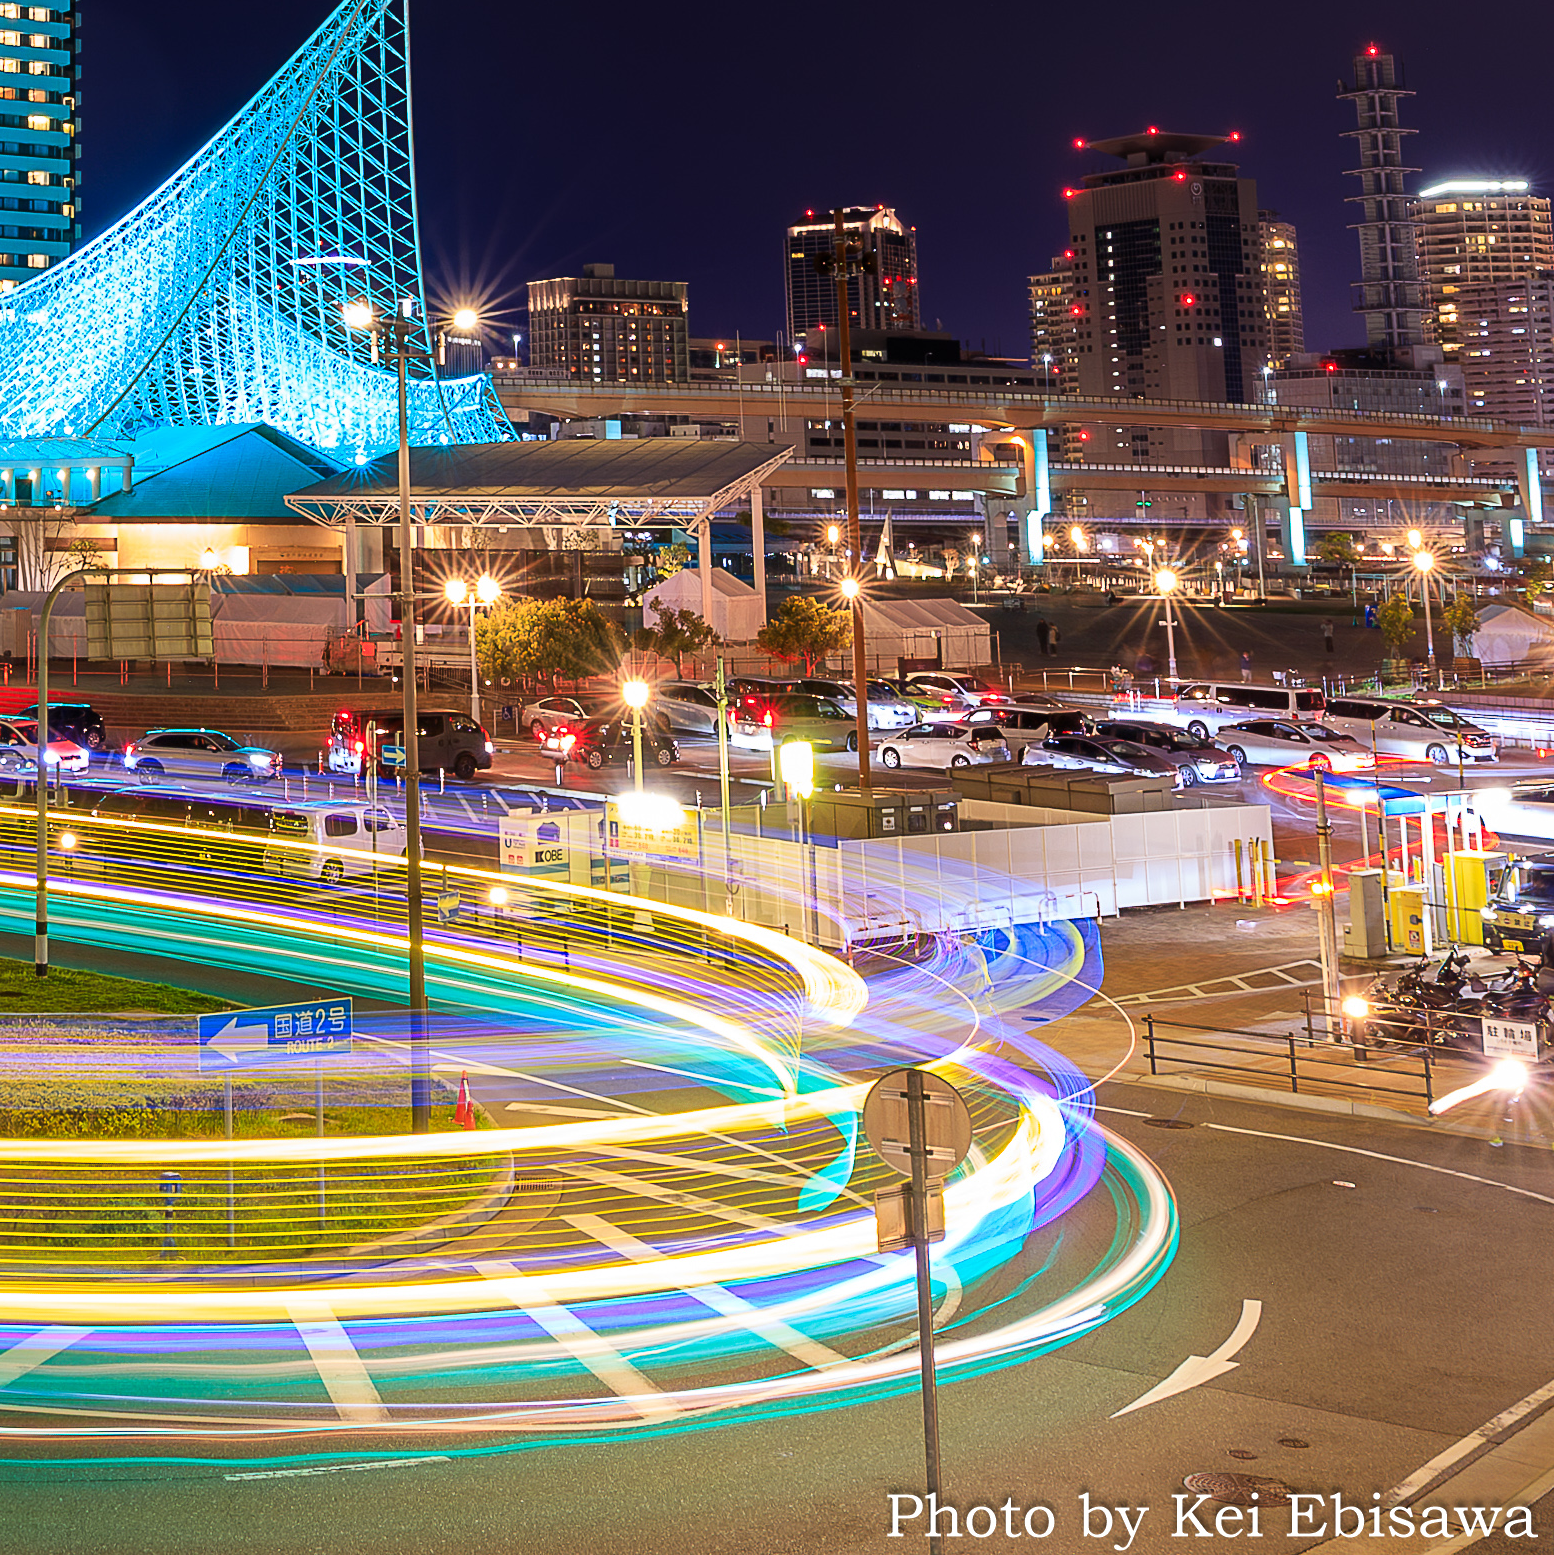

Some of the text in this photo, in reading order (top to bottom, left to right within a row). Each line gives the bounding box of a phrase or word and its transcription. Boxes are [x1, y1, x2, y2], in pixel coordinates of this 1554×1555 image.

[535, 848, 563, 863] KOBE
[274, 1006, 347, 1038] 国道2号
[286, 1037, 323, 1055] ROUTE
